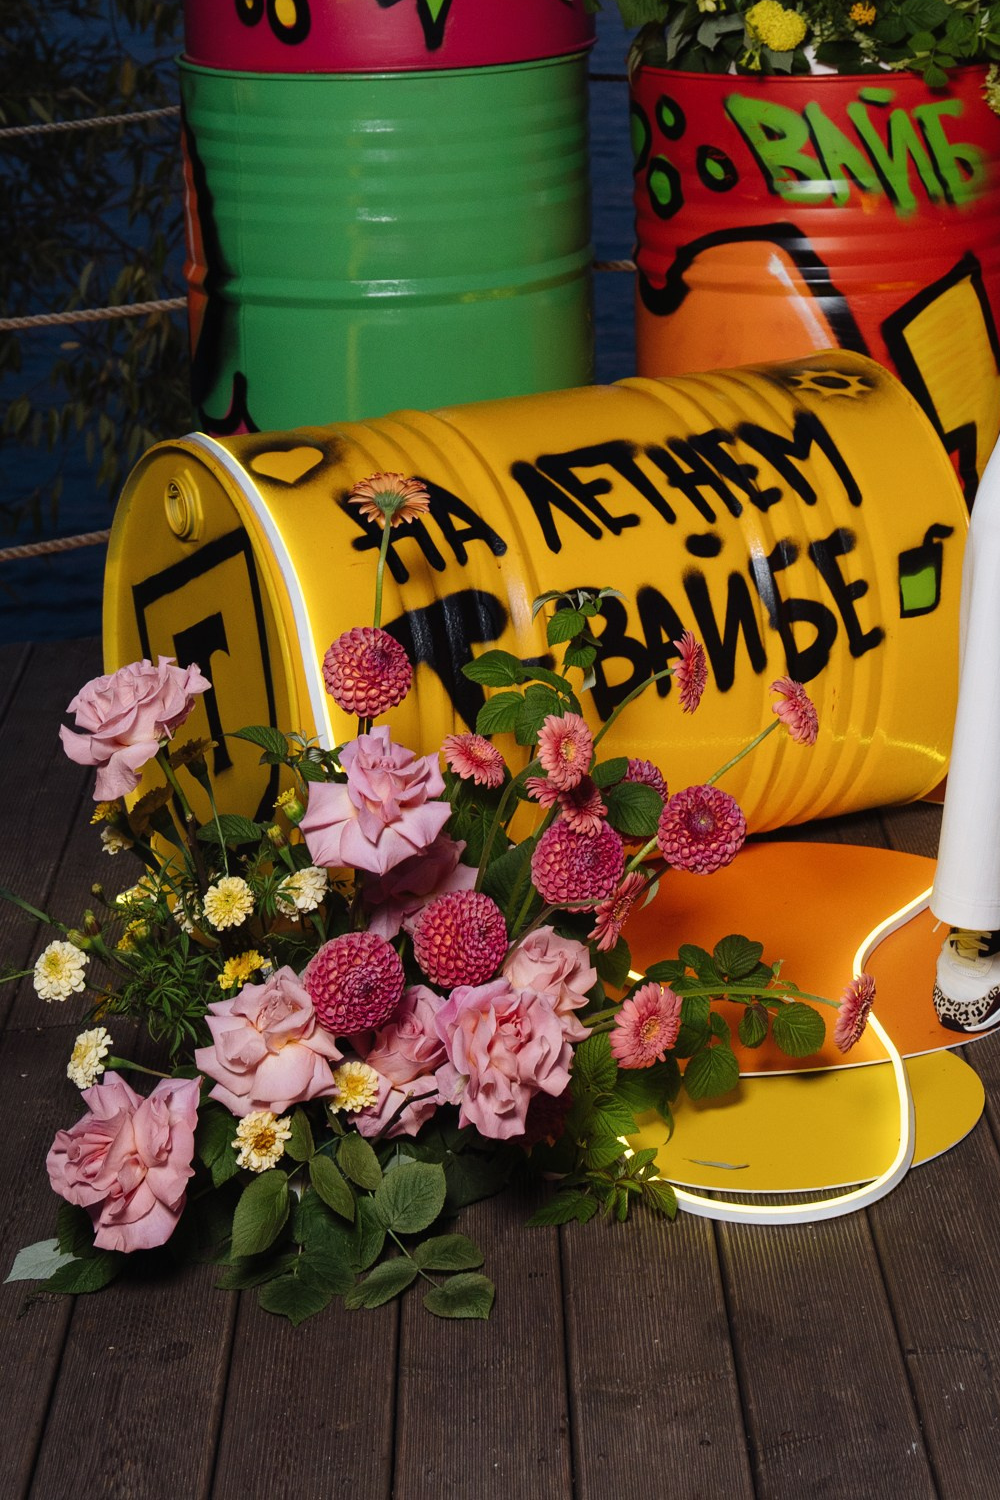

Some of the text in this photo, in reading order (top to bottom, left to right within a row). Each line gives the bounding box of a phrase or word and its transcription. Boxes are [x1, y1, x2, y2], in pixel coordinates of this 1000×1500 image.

[724, 86, 988, 219] ВАЙБ
[335, 406, 863, 584] НА ЛЕТНЕМ
